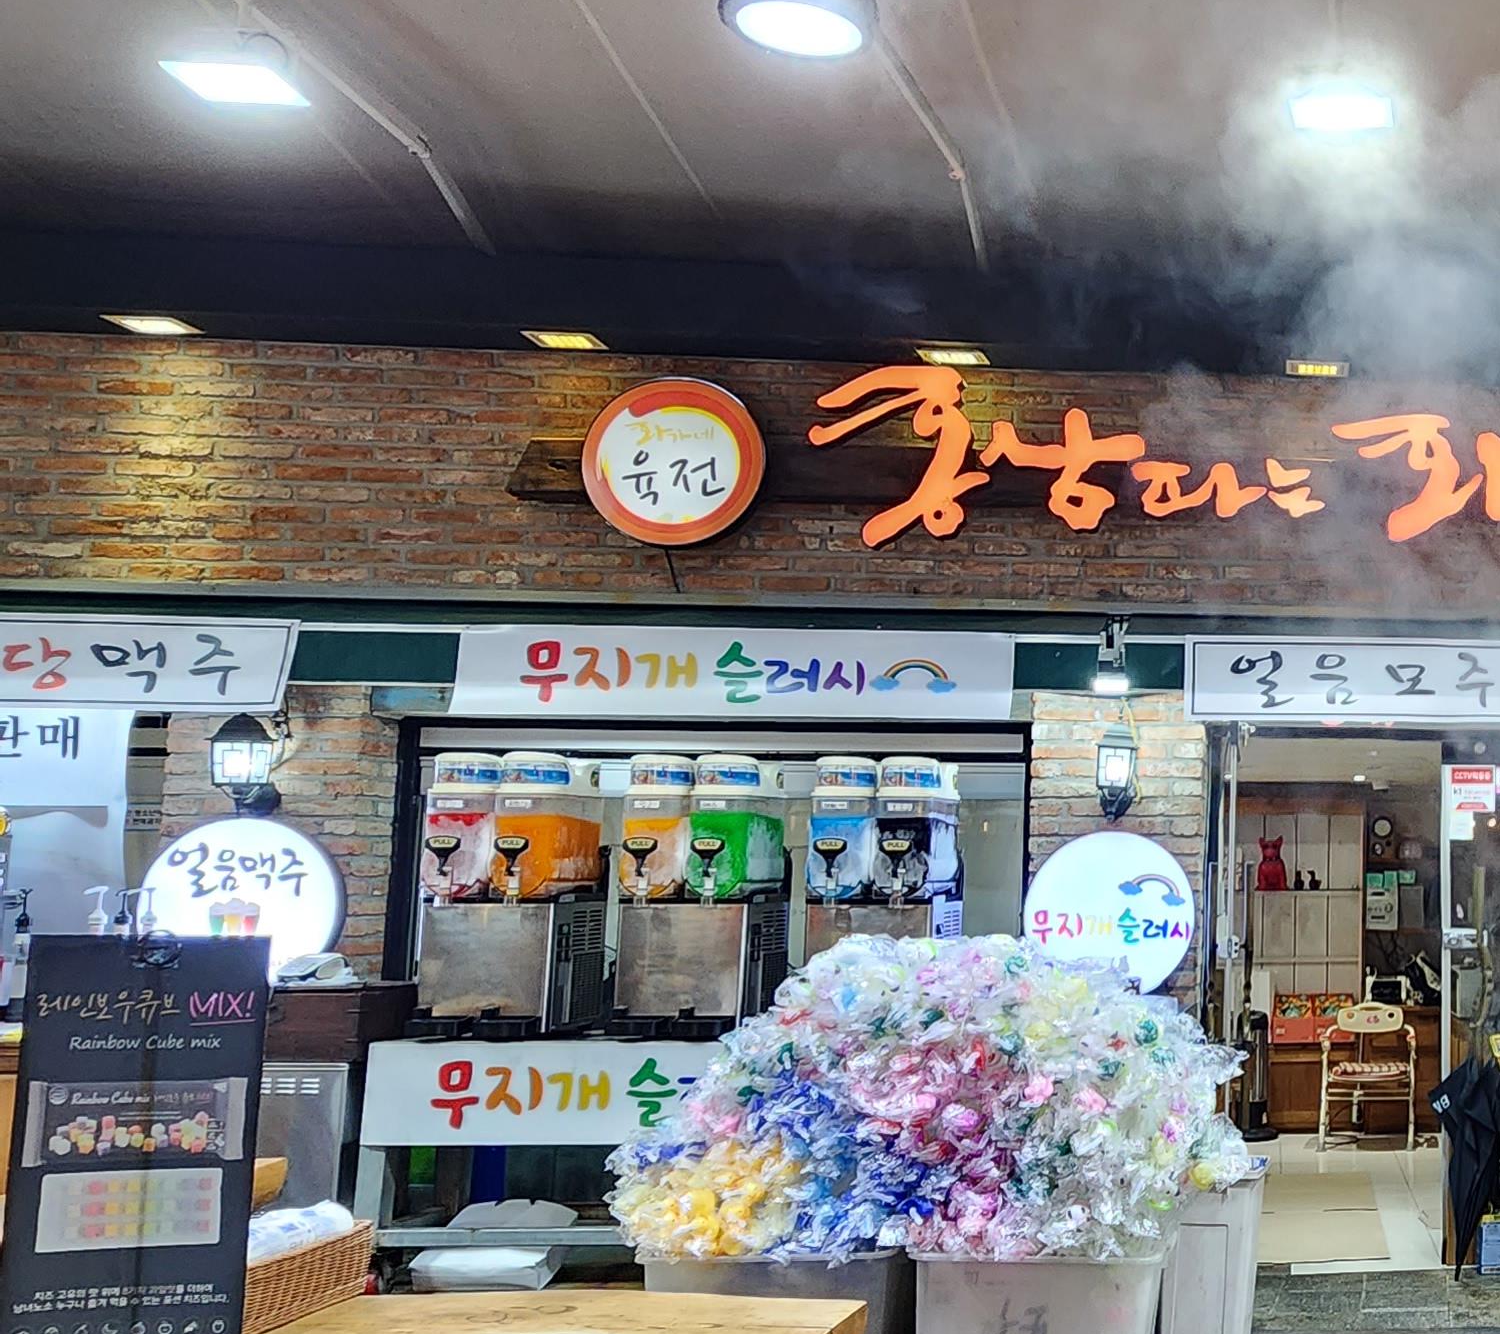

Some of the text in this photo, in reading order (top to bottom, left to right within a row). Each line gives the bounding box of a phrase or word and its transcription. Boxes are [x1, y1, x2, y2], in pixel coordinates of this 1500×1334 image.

[621, 449, 726, 506] 육전
[519, 639, 867, 705] 무지개 슬러시
[167, 842, 309, 898] 얼음맥주
[1031, 906, 1190, 945] 무지개 슬러시
[36, 989, 257, 1027] 레인보우큐브 MIX!
[69, 1033, 222, 1050] Rainbow Cube mix
[430, 1060, 610, 1130] 무지개
